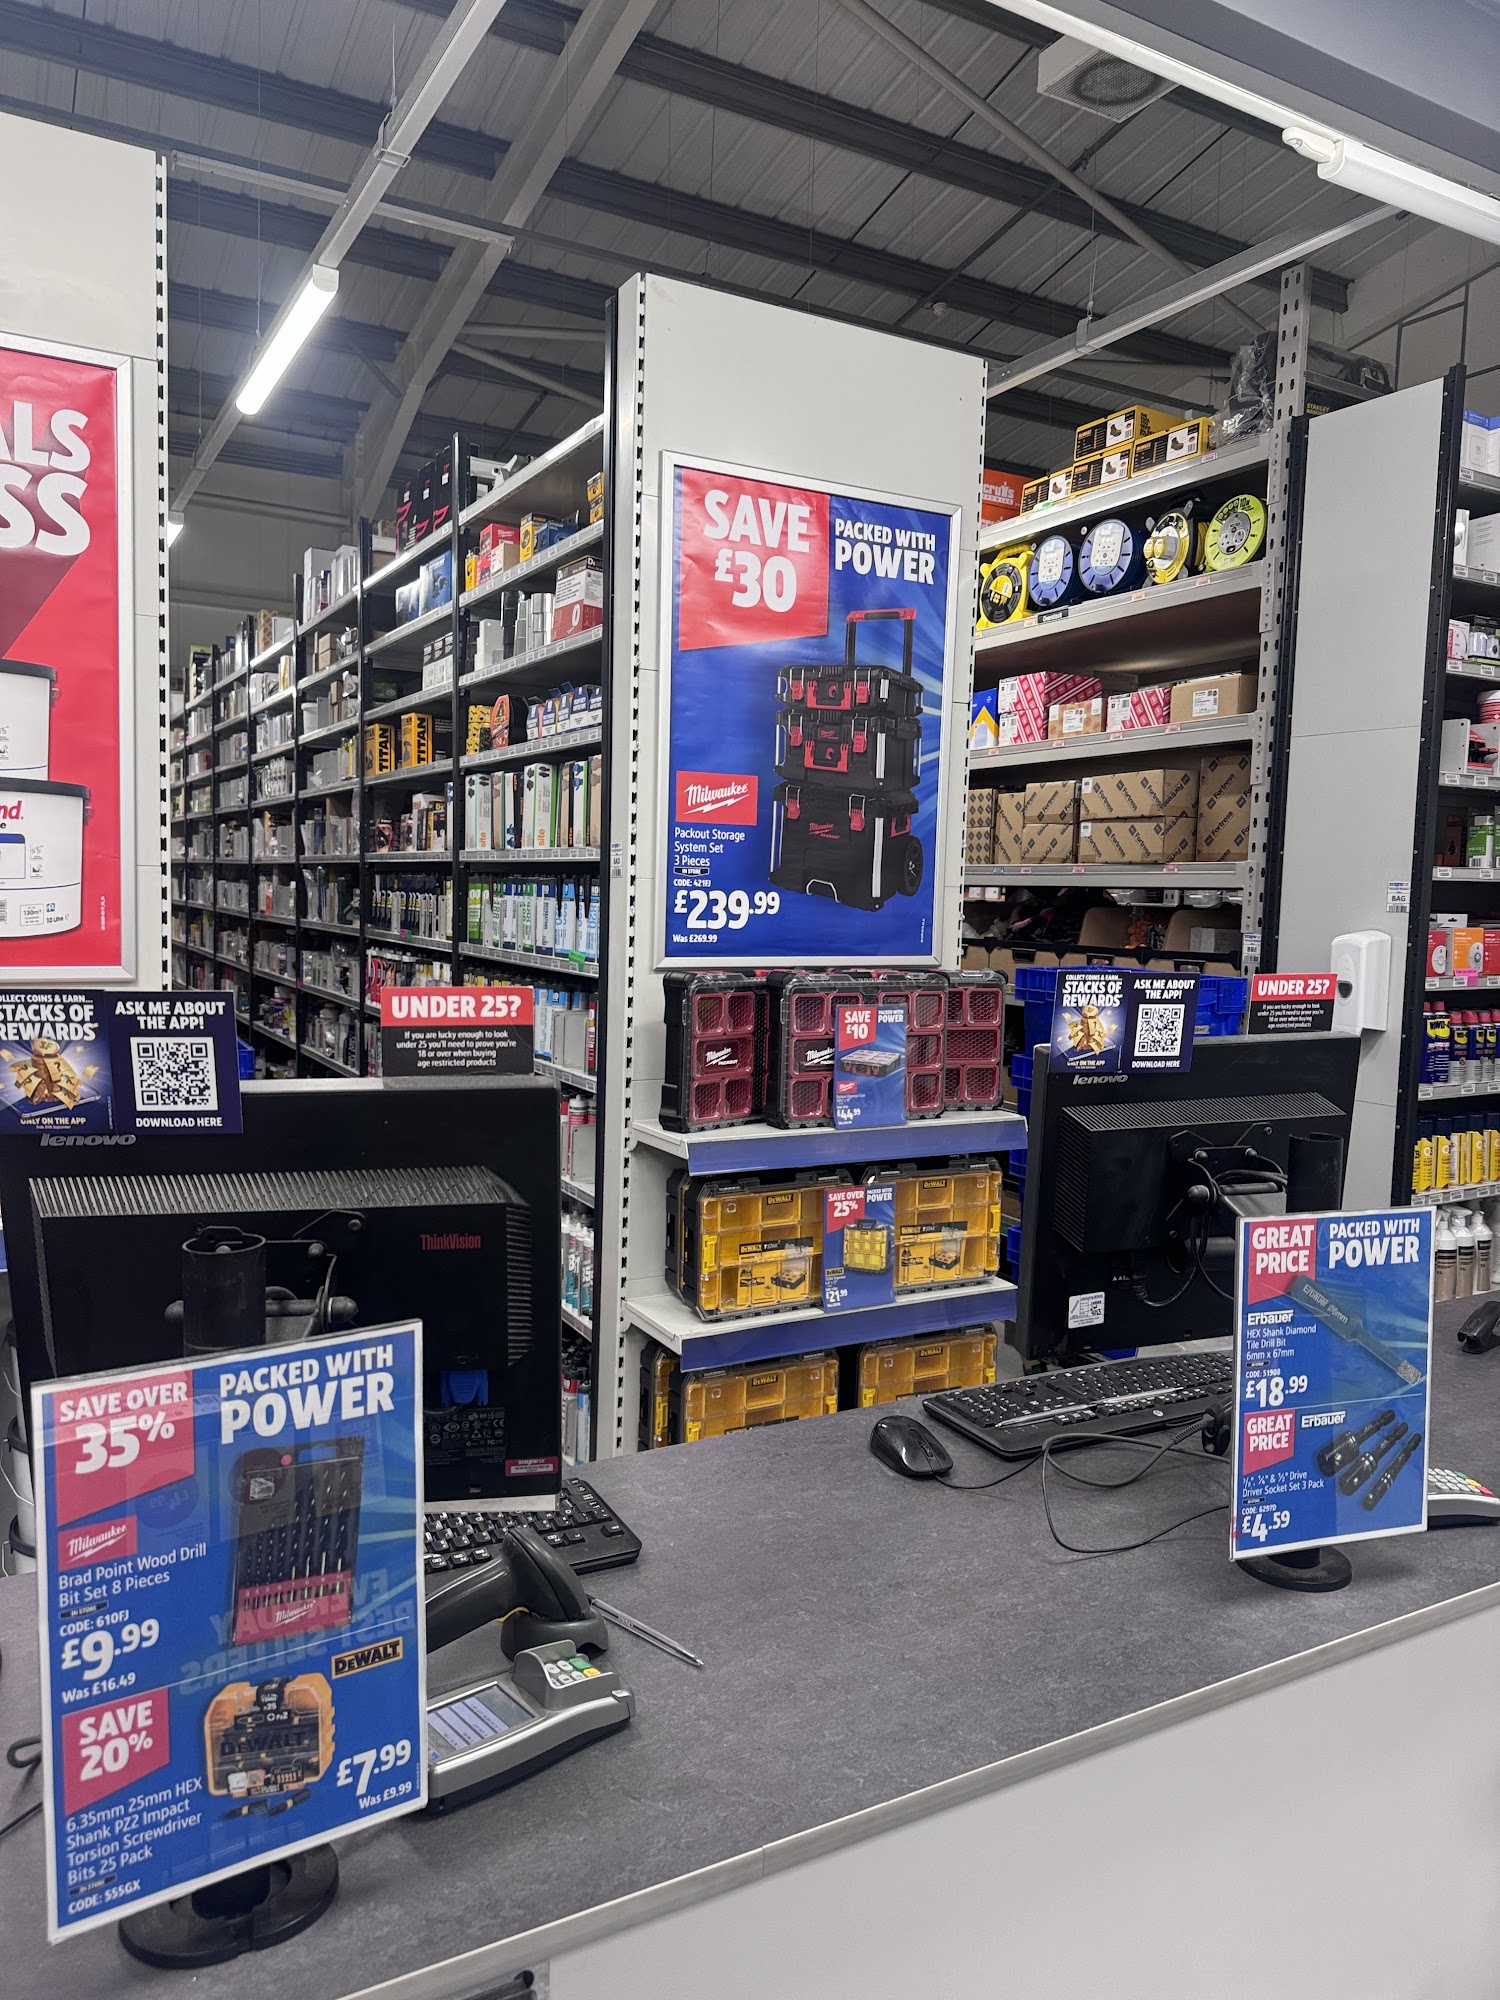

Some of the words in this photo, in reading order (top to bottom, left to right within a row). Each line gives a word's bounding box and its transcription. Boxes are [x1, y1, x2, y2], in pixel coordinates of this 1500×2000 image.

[983, 481, 1014, 498] cruffs
[703, 488, 810, 553] SAVE
[835, 519, 892, 545] PACKED
[895, 525, 936, 551] WITH
[835, 543, 934, 585] POWER
[714, 549, 797, 612] £30
[379, 728, 388, 772] TITAN
[418, 718, 426, 764] TITAN
[684, 781, 750, 807] Milwaukee
[1214, 773, 1235, 799] Fortress
[1099, 790, 1113, 812] Fortress
[1123, 788, 1137, 813] Fortress
[674, 827, 710, 839] Packout
[712, 829, 746, 842] Storage
[674, 841, 707, 854] System
[709, 842, 724, 853] Set
[1135, 833, 1150, 856] Fortress
[674, 855, 680, 866] 3
[682, 855, 710, 866] Pieces
[674, 879, 692, 887] CODE:
[674, 889, 780, 930] £239.99
[672, 934, 688, 943] Was
[689, 934, 718, 943] £269.99
[1064, 982, 1106, 994] STACKS
[1107, 982, 1122, 994] OF
[1134, 980, 1151, 989] ASK
[1152, 980, 1166, 989] ME
[1166, 980, 1195, 989] ABOUT
[1258, 980, 1304, 996] UNDER
[1306, 979, 1330, 994] 25?
[26, 995, 52, 1003] COINS
[54, 995, 61, 1003] &
[1063, 994, 1122, 1007] REWARDS
[1146, 990, 1160, 999] THE
[1162, 990, 1182, 999] APP!
[69, 1005, 94, 1022] OF
[115, 1001, 147, 1016] ASK
[149, 1001, 168, 1016] ME
[170, 1001, 226, 1015] ABOUT
[391, 996, 477, 1018] UNDER
[480, 995, 521, 1018] 25?
[136, 1016, 163, 1031] THE
[166, 1015, 205, 1030] APP!
[844, 1010, 871, 1023] SAVE
[878, 1015, 904, 1023] POWER
[411, 1032, 424, 1040] you
[438, 1031, 456, 1040] lucky
[457, 1031, 484, 1040] enough
[494, 1030, 509, 1038] look
[846, 1024, 869, 1039] £10
[428, 1040, 446, 1049] you'll
[447, 1040, 465, 1048] need
[495, 1040, 517, 1048] you're
[473, 1050, 496, 1058] buying
[706, 1048, 731, 1062] Milwaukee
[417, 1060, 430, 1068] age
[431, 1059, 465, 1067] restricted
[466, 1059, 496, 1067] products
[1073, 1073, 1128, 1085] lenovo
[20, 1117, 40, 1125] ONLY
[41, 1117, 53, 1125] ON
[55, 1117, 70, 1125] THE
[71, 1117, 86, 1125] APP
[135, 1117, 193, 1129] DOWNLOAD
[196, 1117, 223, 1128] HERE
[837, 1108, 861, 1120] £44.99
[40, 1133, 136, 1147] lenovo
[924, 1180, 946, 1188] DEWALT
[768, 1195, 792, 1204] DEWALT
[828, 1192, 845, 1201] SAVE
[846, 1190, 864, 1199] OVER
[866, 1193, 892, 1202] POWER
[833, 1200, 858, 1217] 25%
[1252, 1224, 1314, 1250] GREAT
[1329, 1220, 1380, 1240] PACKED
[1383, 1218, 1420, 1234] WITH
[421, 1233, 481, 1250] ThinkVision
[1329, 1236, 1420, 1269] POWER
[1255, 1250, 1309, 1275] PRICE
[826, 1289, 848, 1303] £21.99
[1302, 1284, 1329, 1309] Erbauer
[1247, 1310, 1293, 1326] Erbauer
[1247, 1327, 1260, 1339] HEX
[1262, 1327, 1284, 1338] Shank
[1285, 1324, 1316, 1336] Diamond
[920, 1347, 942, 1357] DEWALT
[1247, 1340, 1259, 1350] Tile
[1261, 1339, 1275, 1348] Drill
[1276, 1338, 1286, 1347] Bit
[1246, 1351, 1265, 1360] 6mm
[1273, 1349, 1294, 1358] 67mm
[220, 1359, 319, 1398] PACKED
[325, 1344, 393, 1376] WITH
[753, 1375, 778, 1385] DEWALT
[1246, 1375, 1308, 1408] £18.99
[60, 1392, 123, 1423] SAVE
[127, 1381, 188, 1410] OVER
[220, 1372, 395, 1445] POWER
[1246, 1414, 1293, 1435] GREAT
[1301, 1411, 1346, 1429] Erbauer
[75, 1412, 175, 1474] 35%
[1249, 1434, 1289, 1452] PRICE
[1290, 1472, 1307, 1480] Drive
[1242, 1488, 1262, 1498] Driver
[1264, 1484, 1287, 1495] Socket
[1289, 1482, 1300, 1491] Set
[1302, 1481, 1306, 1489] 3
[1308, 1479, 1324, 1489] Pack
[1242, 1507, 1258, 1515] CODE:
[1242, 1510, 1290, 1542] £4.59
[67, 1524, 127, 1556] Milwaukee
[59, 1570, 92, 1590] Brad
[96, 1561, 133, 1584] Point
[137, 1551, 177, 1570] Wood
[180, 1543, 206, 1560] Drill
[59, 1588, 82, 1607] Bit
[85, 1584, 109, 1601] Set
[113, 1579, 121, 1594] 8
[125, 1570, 170, 1592] Pieces
[275, 1600, 316, 1626] Milwaukee
[60, 1619, 94, 1637] CODE:
[96, 1609, 129, 1627] 610FJ
[61, 1619, 159, 1682] £9.99
[334, 1642, 400, 1675] DEWALT
[62, 1686, 90, 1704] Was
[92, 1673, 136, 1694] £16.49
[79, 1700, 153, 1745] SAVE
[80, 1731, 153, 1782] 20%
[336, 1739, 412, 1796] £7.99
[359, 1794, 381, 1809] Was
[383, 1782, 412, 1803] £9.99
[66, 1808, 125, 1833] 6.35mm
[128, 1794, 172, 1817] 25mm
[175, 1777, 203, 1798] HEX
[67, 1824, 111, 1852] Shank
[114, 1817, 140, 1836] PZ2
[142, 1799, 190, 1830] Impact
[67, 1841, 119, 1867] Torsion
[122, 1812, 202, 1850] Screwdriver
[68, 1863, 96, 1885] Bits
[99, 1858, 117, 1875] 25
[120, 1846, 153, 1867] Pack
[68, 1894, 102, 1914] CODE:
